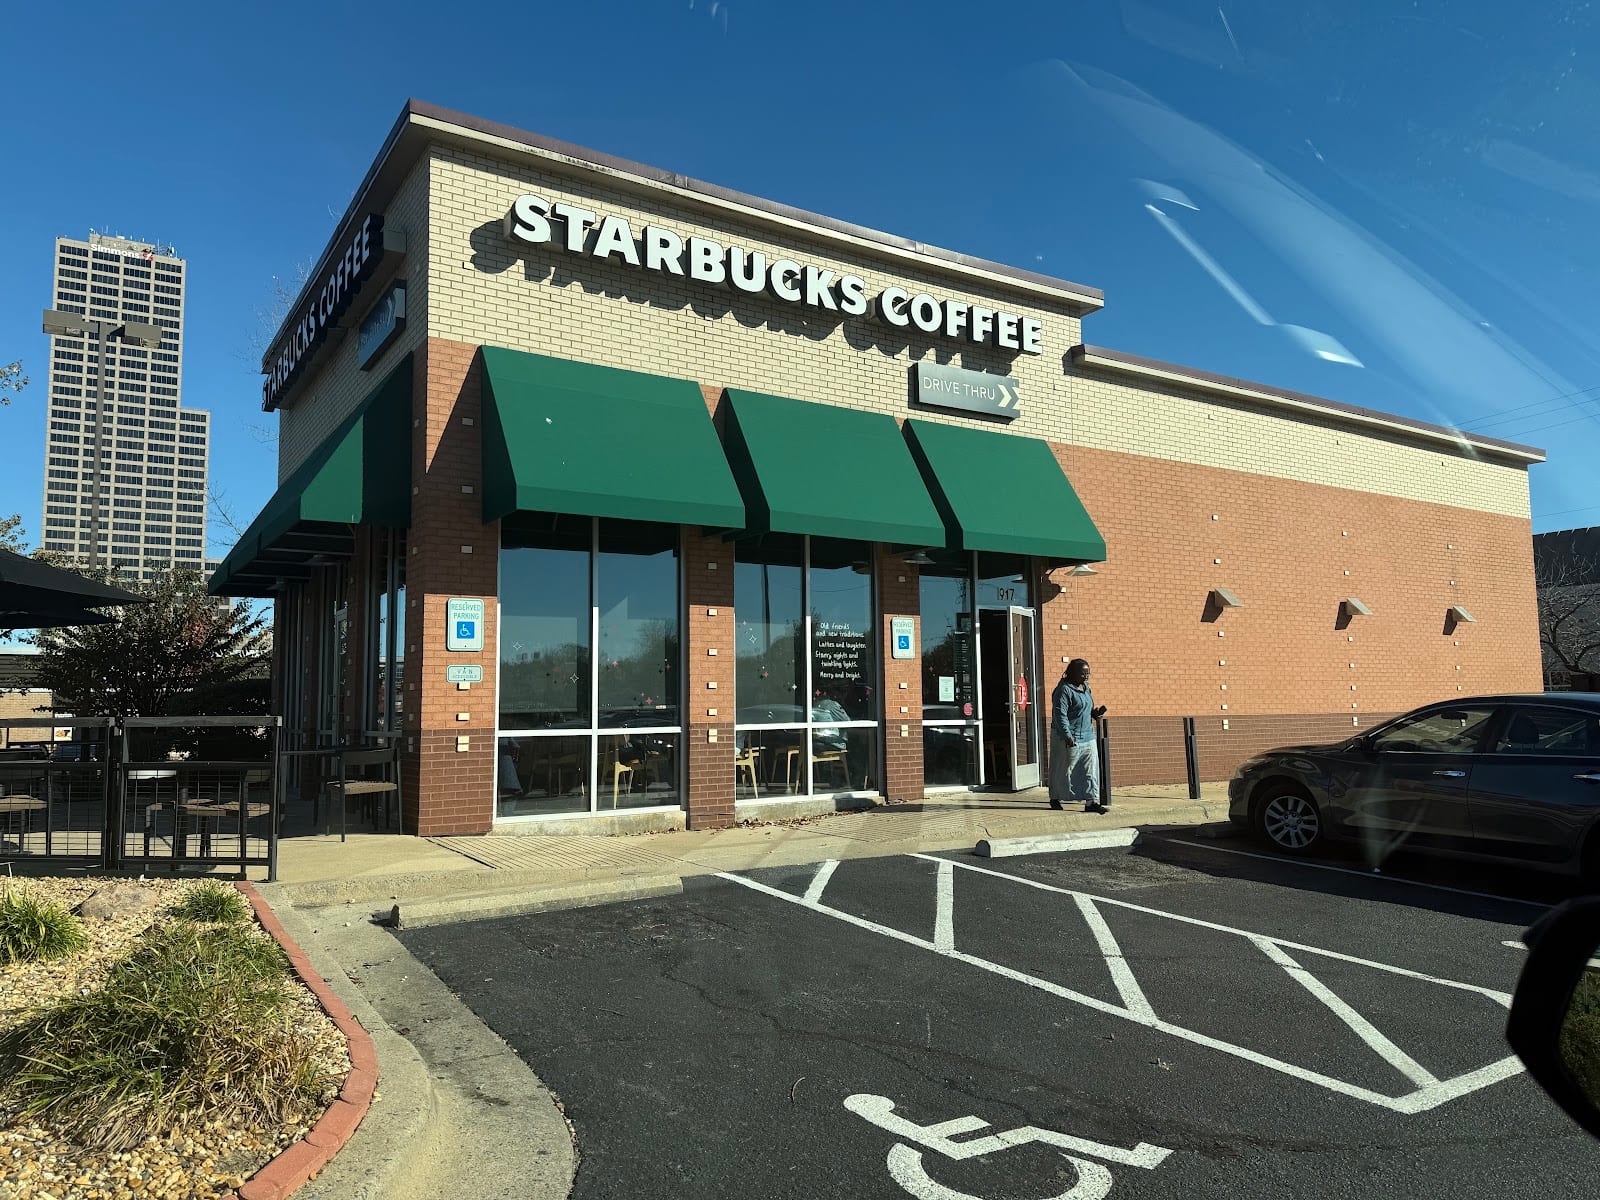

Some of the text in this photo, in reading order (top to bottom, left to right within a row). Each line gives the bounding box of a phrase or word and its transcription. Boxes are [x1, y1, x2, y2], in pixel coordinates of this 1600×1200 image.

[90, 243, 140, 259] Simmons
[511, 192, 1043, 354] STARBUCKS COFFEE
[262, 214, 371, 410] STARBUCKS COFFEE
[923, 377, 996, 400] DRIVE THRU
[451, 603, 481, 612] RESERVED
[453, 612, 480, 620] PARKING
[820, 622, 850, 630] Old friends
[815, 650, 832, 660] Starry
[848, 651, 859, 659] and
[820, 671, 834, 680] Merry
[834, 671, 844, 679] and
